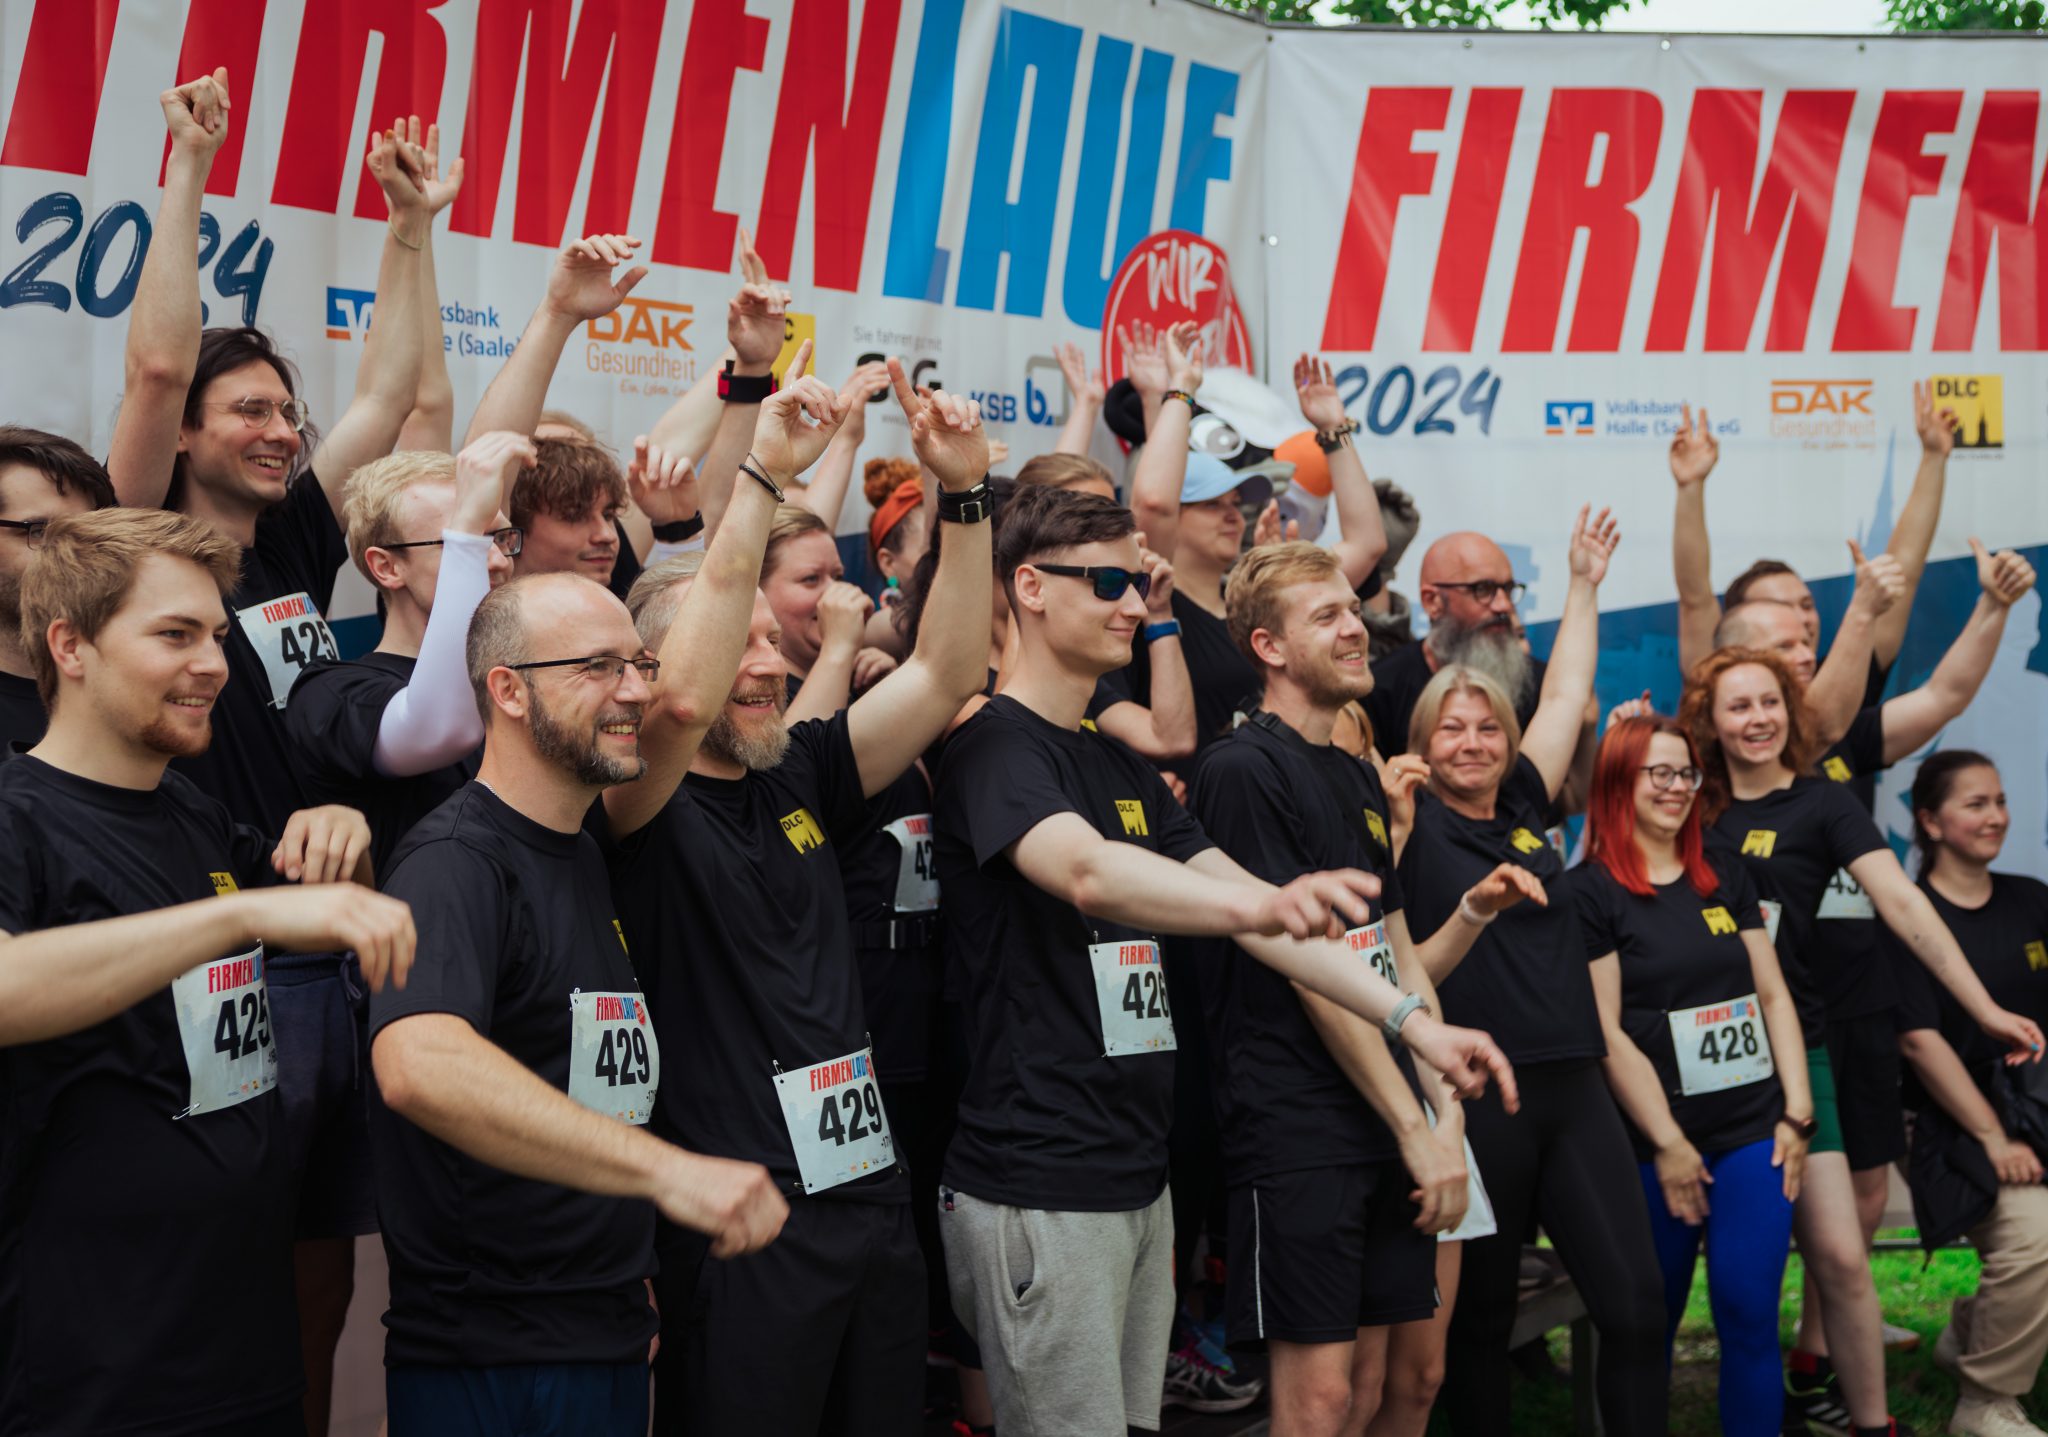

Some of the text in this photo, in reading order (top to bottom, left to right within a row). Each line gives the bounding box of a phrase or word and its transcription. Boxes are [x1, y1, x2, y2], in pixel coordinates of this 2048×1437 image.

[1320, 87, 2048, 352] FIRMEN
[1147, 239, 1217, 312] WIR
[440, 301, 499, 328] ksbank
[587, 292, 694, 351] DAK
[854, 326, 873, 343] Sie
[586, 337, 697, 383] Gesundheit
[970, 391, 1017, 423] KSB
[1336, 365, 1502, 436] 2024
[1605, 399, 1687, 415] Volksban
[1771, 379, 1873, 415] DAK
[1937, 379, 1979, 397] DLC
[281, 620, 336, 669] 425
[781, 814, 804, 832] DLC
[1118, 802, 1136, 813] DLC
[1370, 948, 1399, 989] 26
[1122, 970, 1171, 1020] 426
[214, 988, 271, 1062] 425
[1699, 1021, 1759, 1065] 428
[595, 1027, 650, 1087] 429
[818, 1082, 883, 1147] 429
